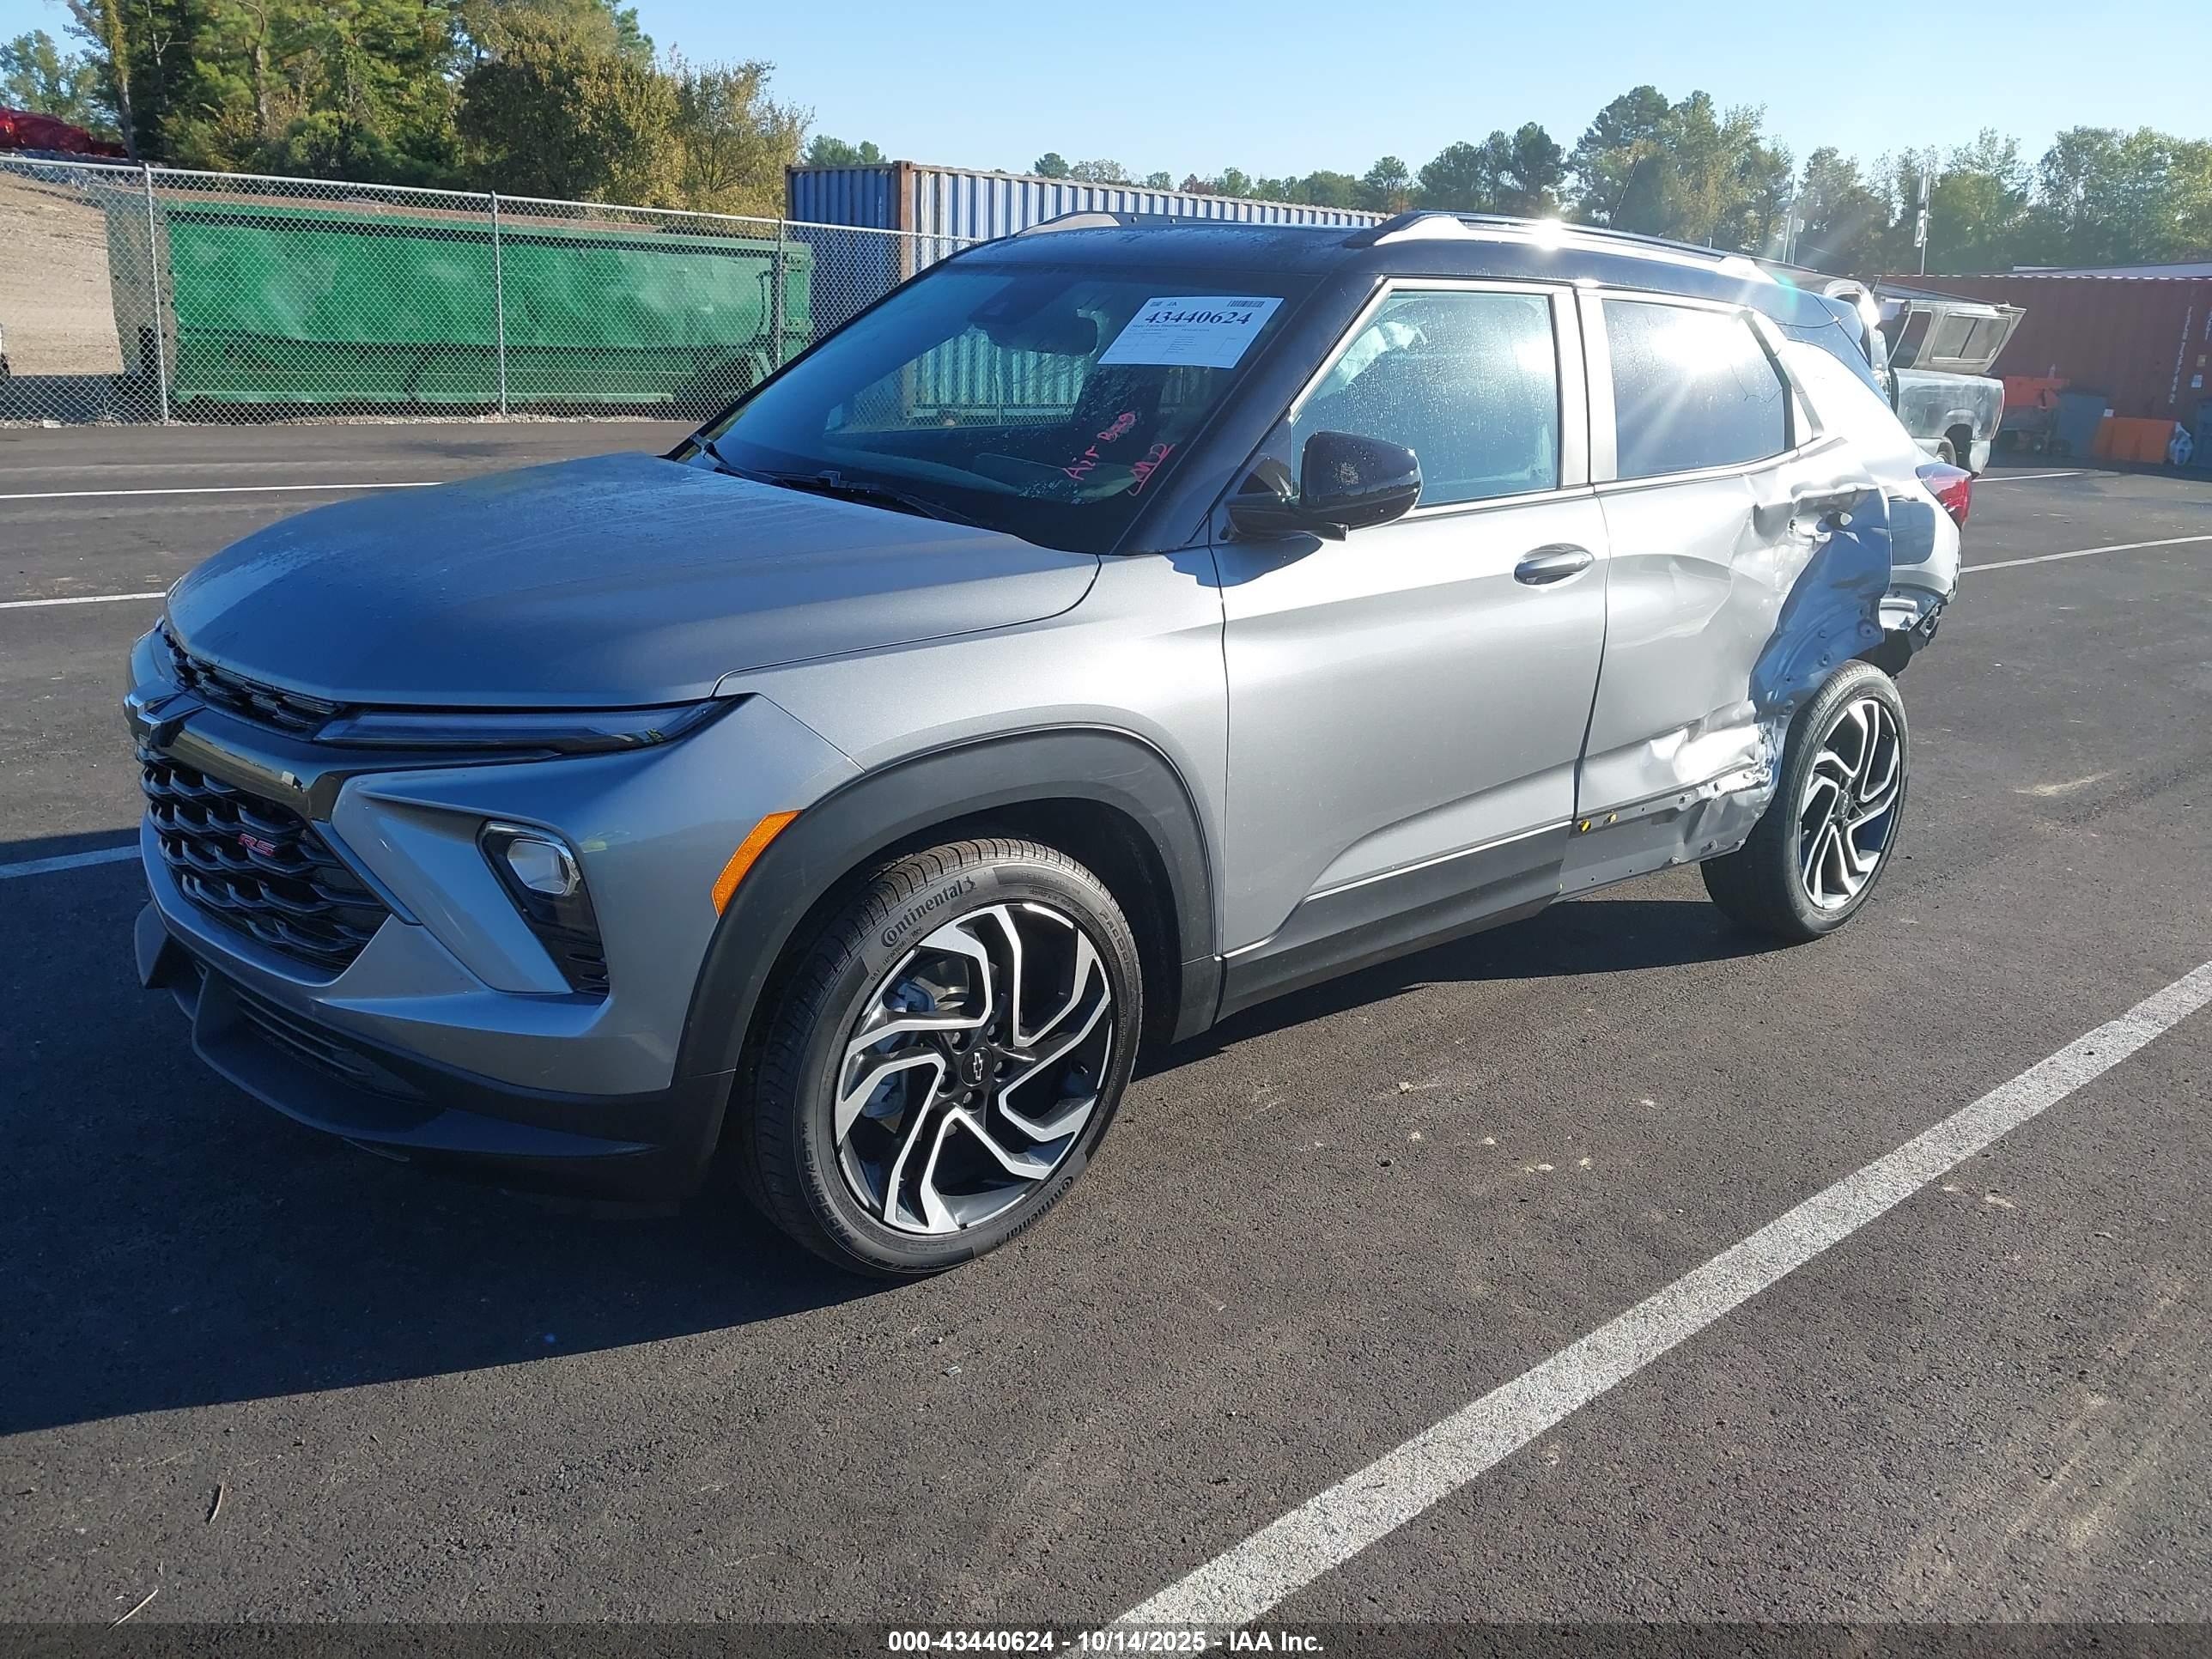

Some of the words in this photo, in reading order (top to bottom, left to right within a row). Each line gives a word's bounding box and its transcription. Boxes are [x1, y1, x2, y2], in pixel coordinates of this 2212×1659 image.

[1146, 310, 1254, 325] 43440624
[238, 833, 276, 857] RS
[881, 879, 963, 948] Continental
